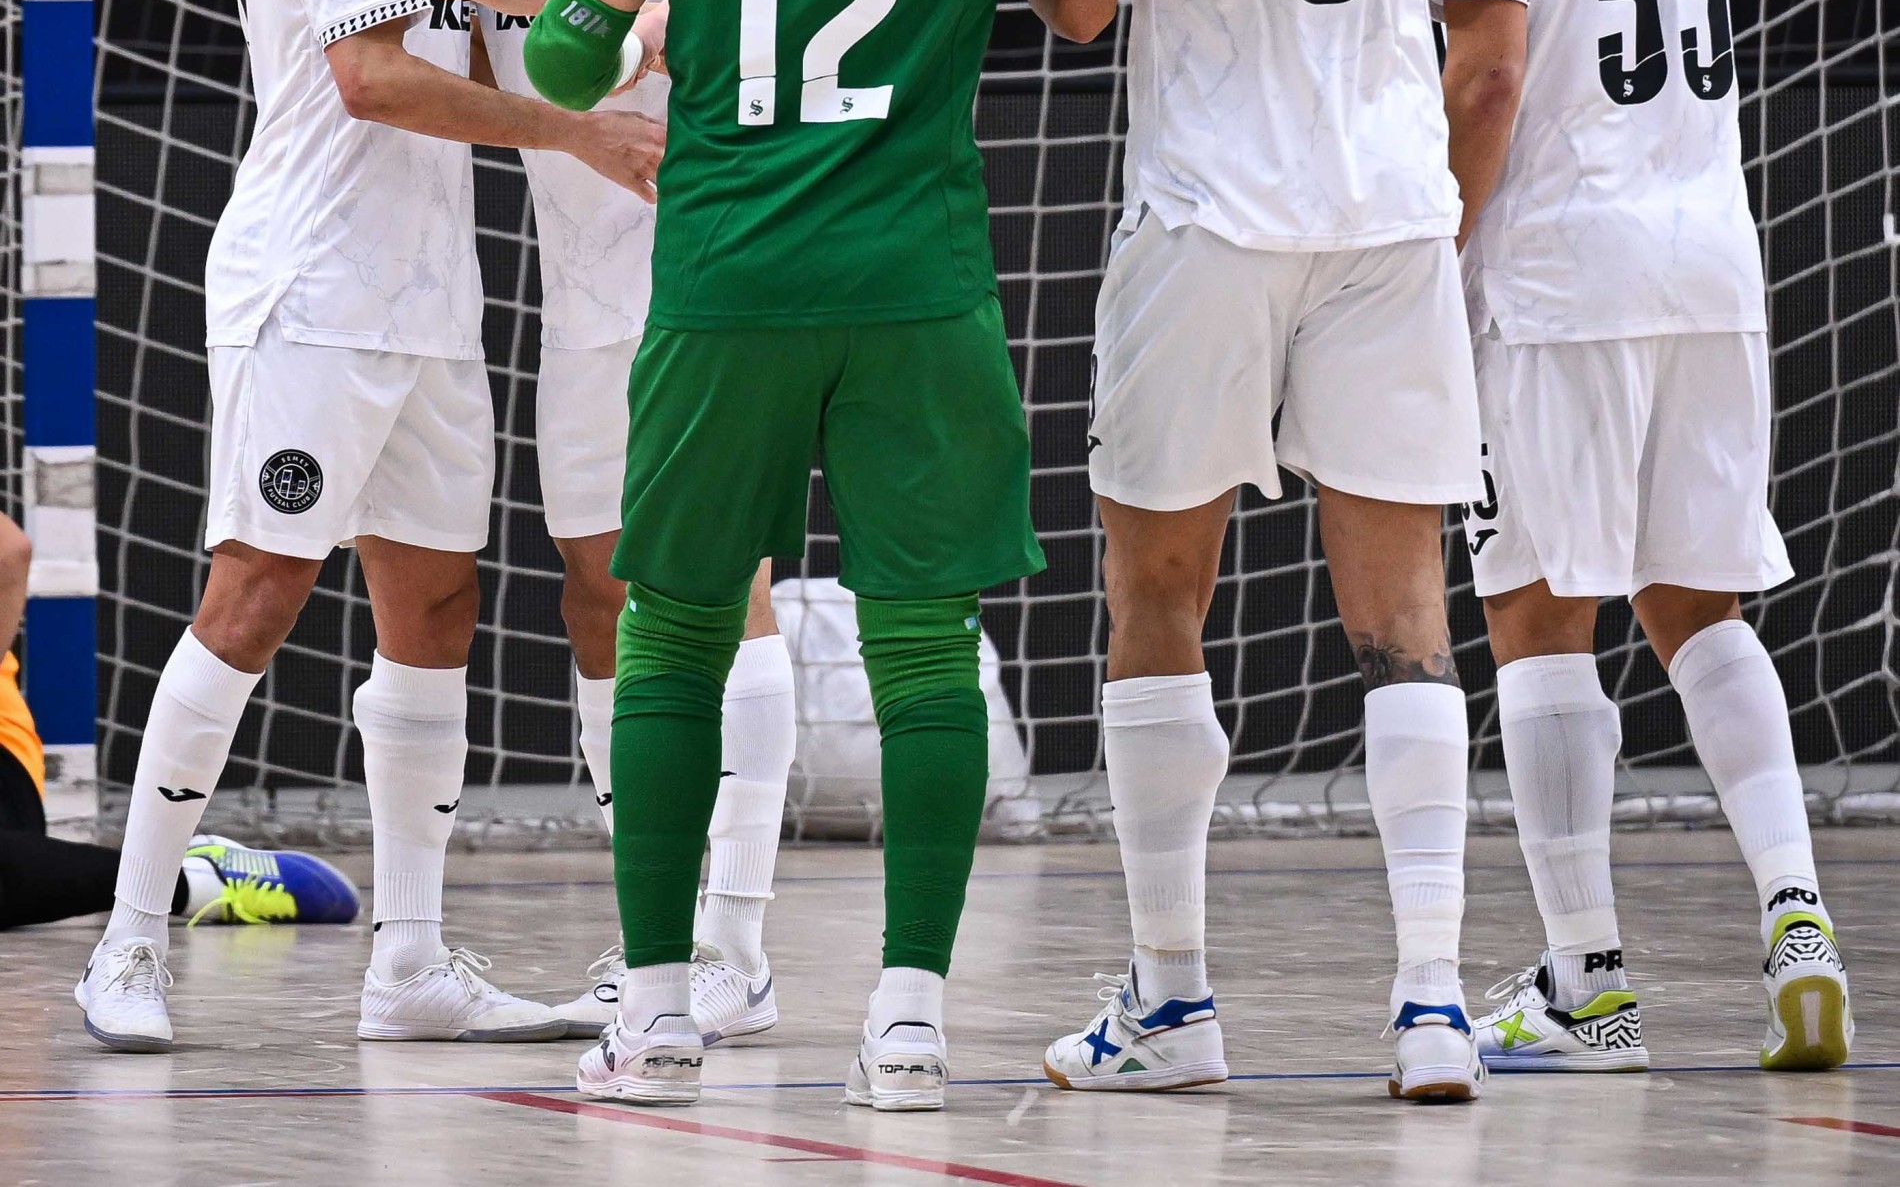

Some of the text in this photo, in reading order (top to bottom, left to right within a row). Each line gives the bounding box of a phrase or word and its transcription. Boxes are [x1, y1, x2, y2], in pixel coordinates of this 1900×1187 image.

[281, 456, 309, 467] SEMEY
[268, 488, 311, 508] FUTSAL CLUB
[1767, 886, 1818, 912] PRO
